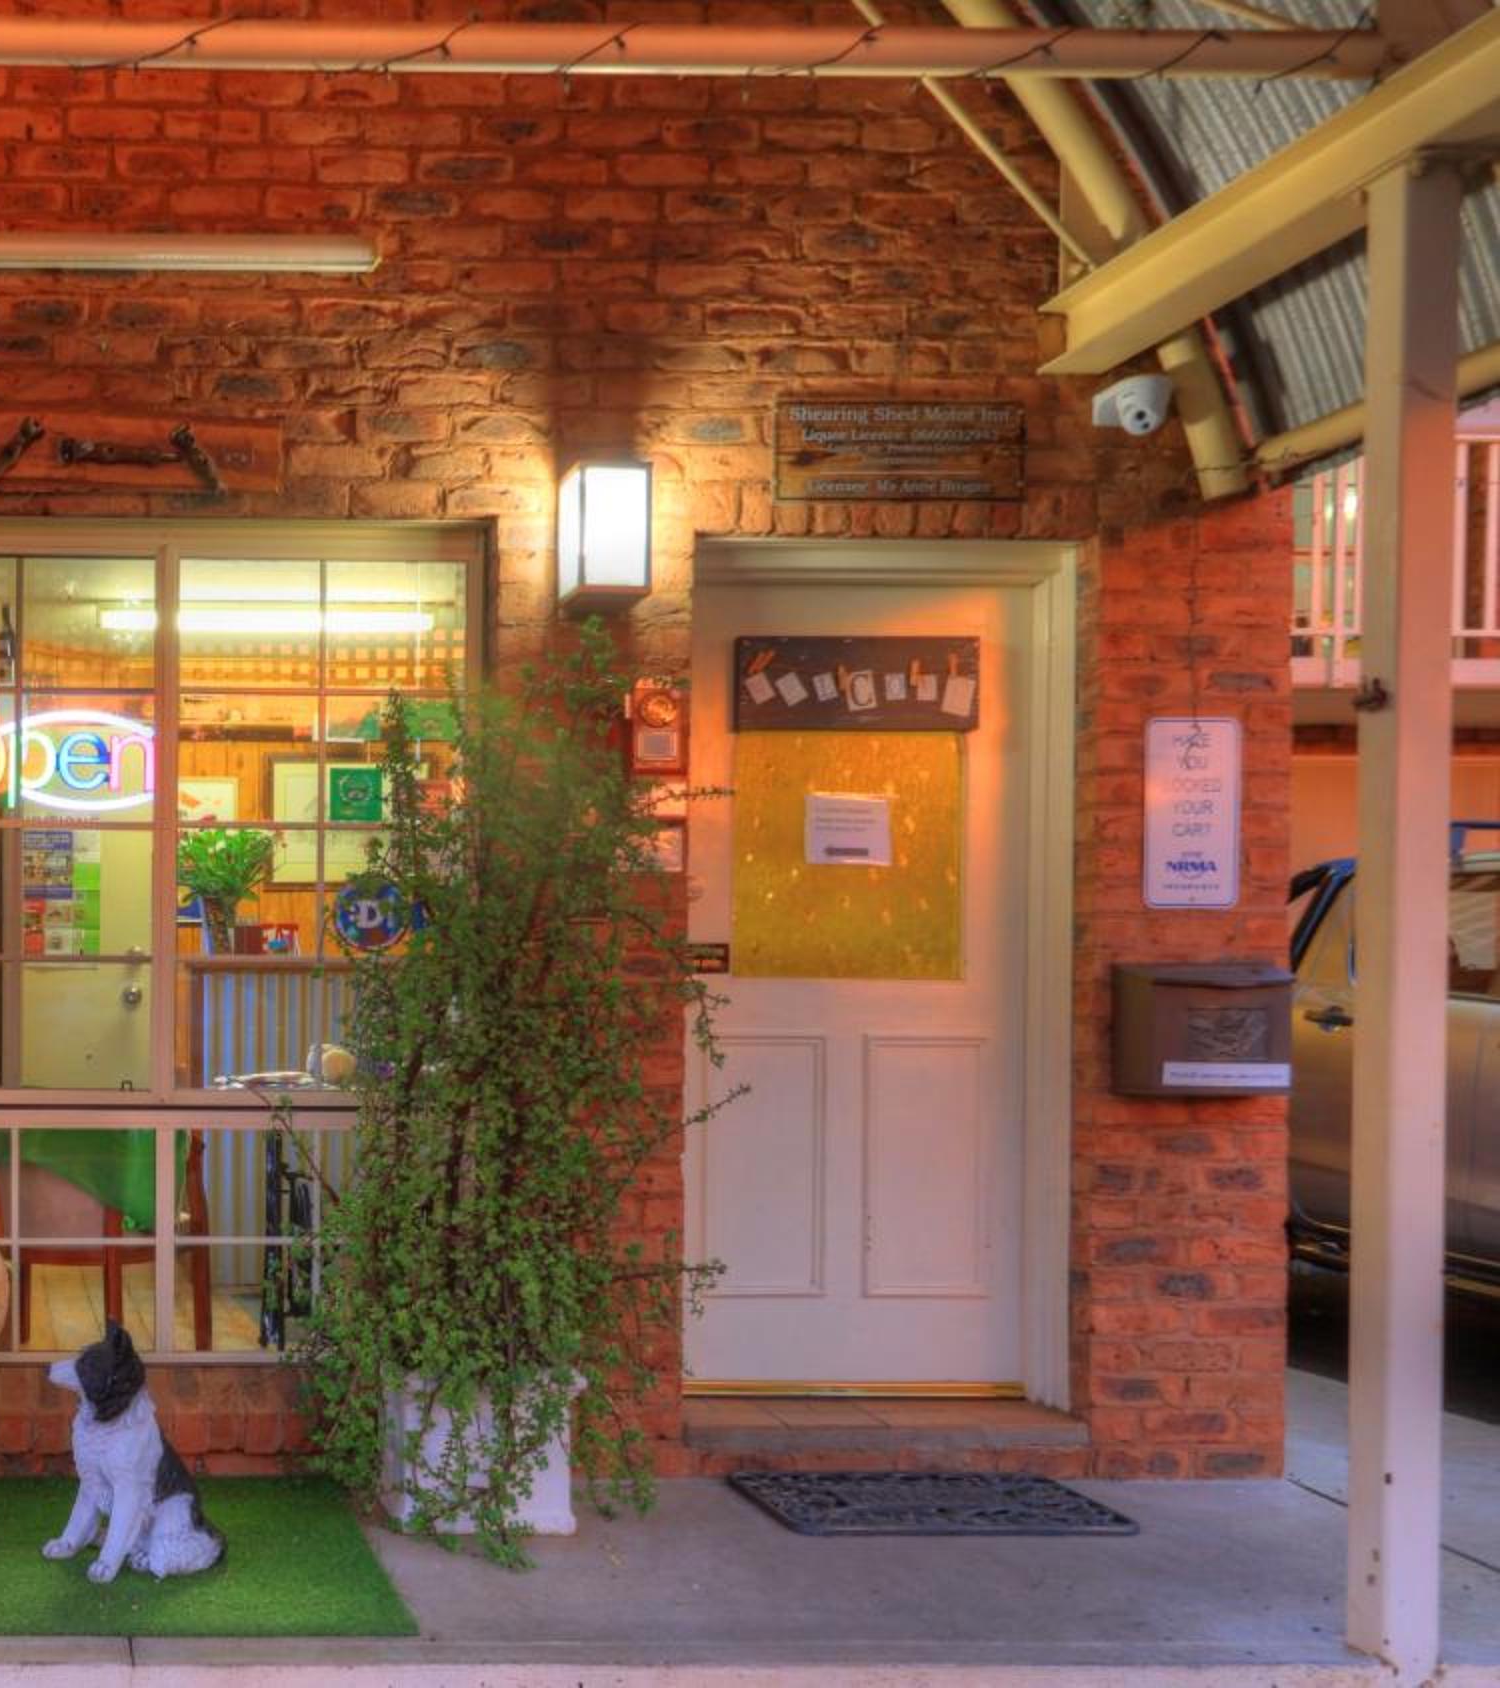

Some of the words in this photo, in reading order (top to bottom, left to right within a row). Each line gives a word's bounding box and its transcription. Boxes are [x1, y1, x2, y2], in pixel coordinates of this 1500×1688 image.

[790, 406, 868, 425] Shearing
[874, 406, 917, 422] Shed
[1172, 799, 1214, 815] YOUR
[1165, 861, 1218, 873] NRMA
